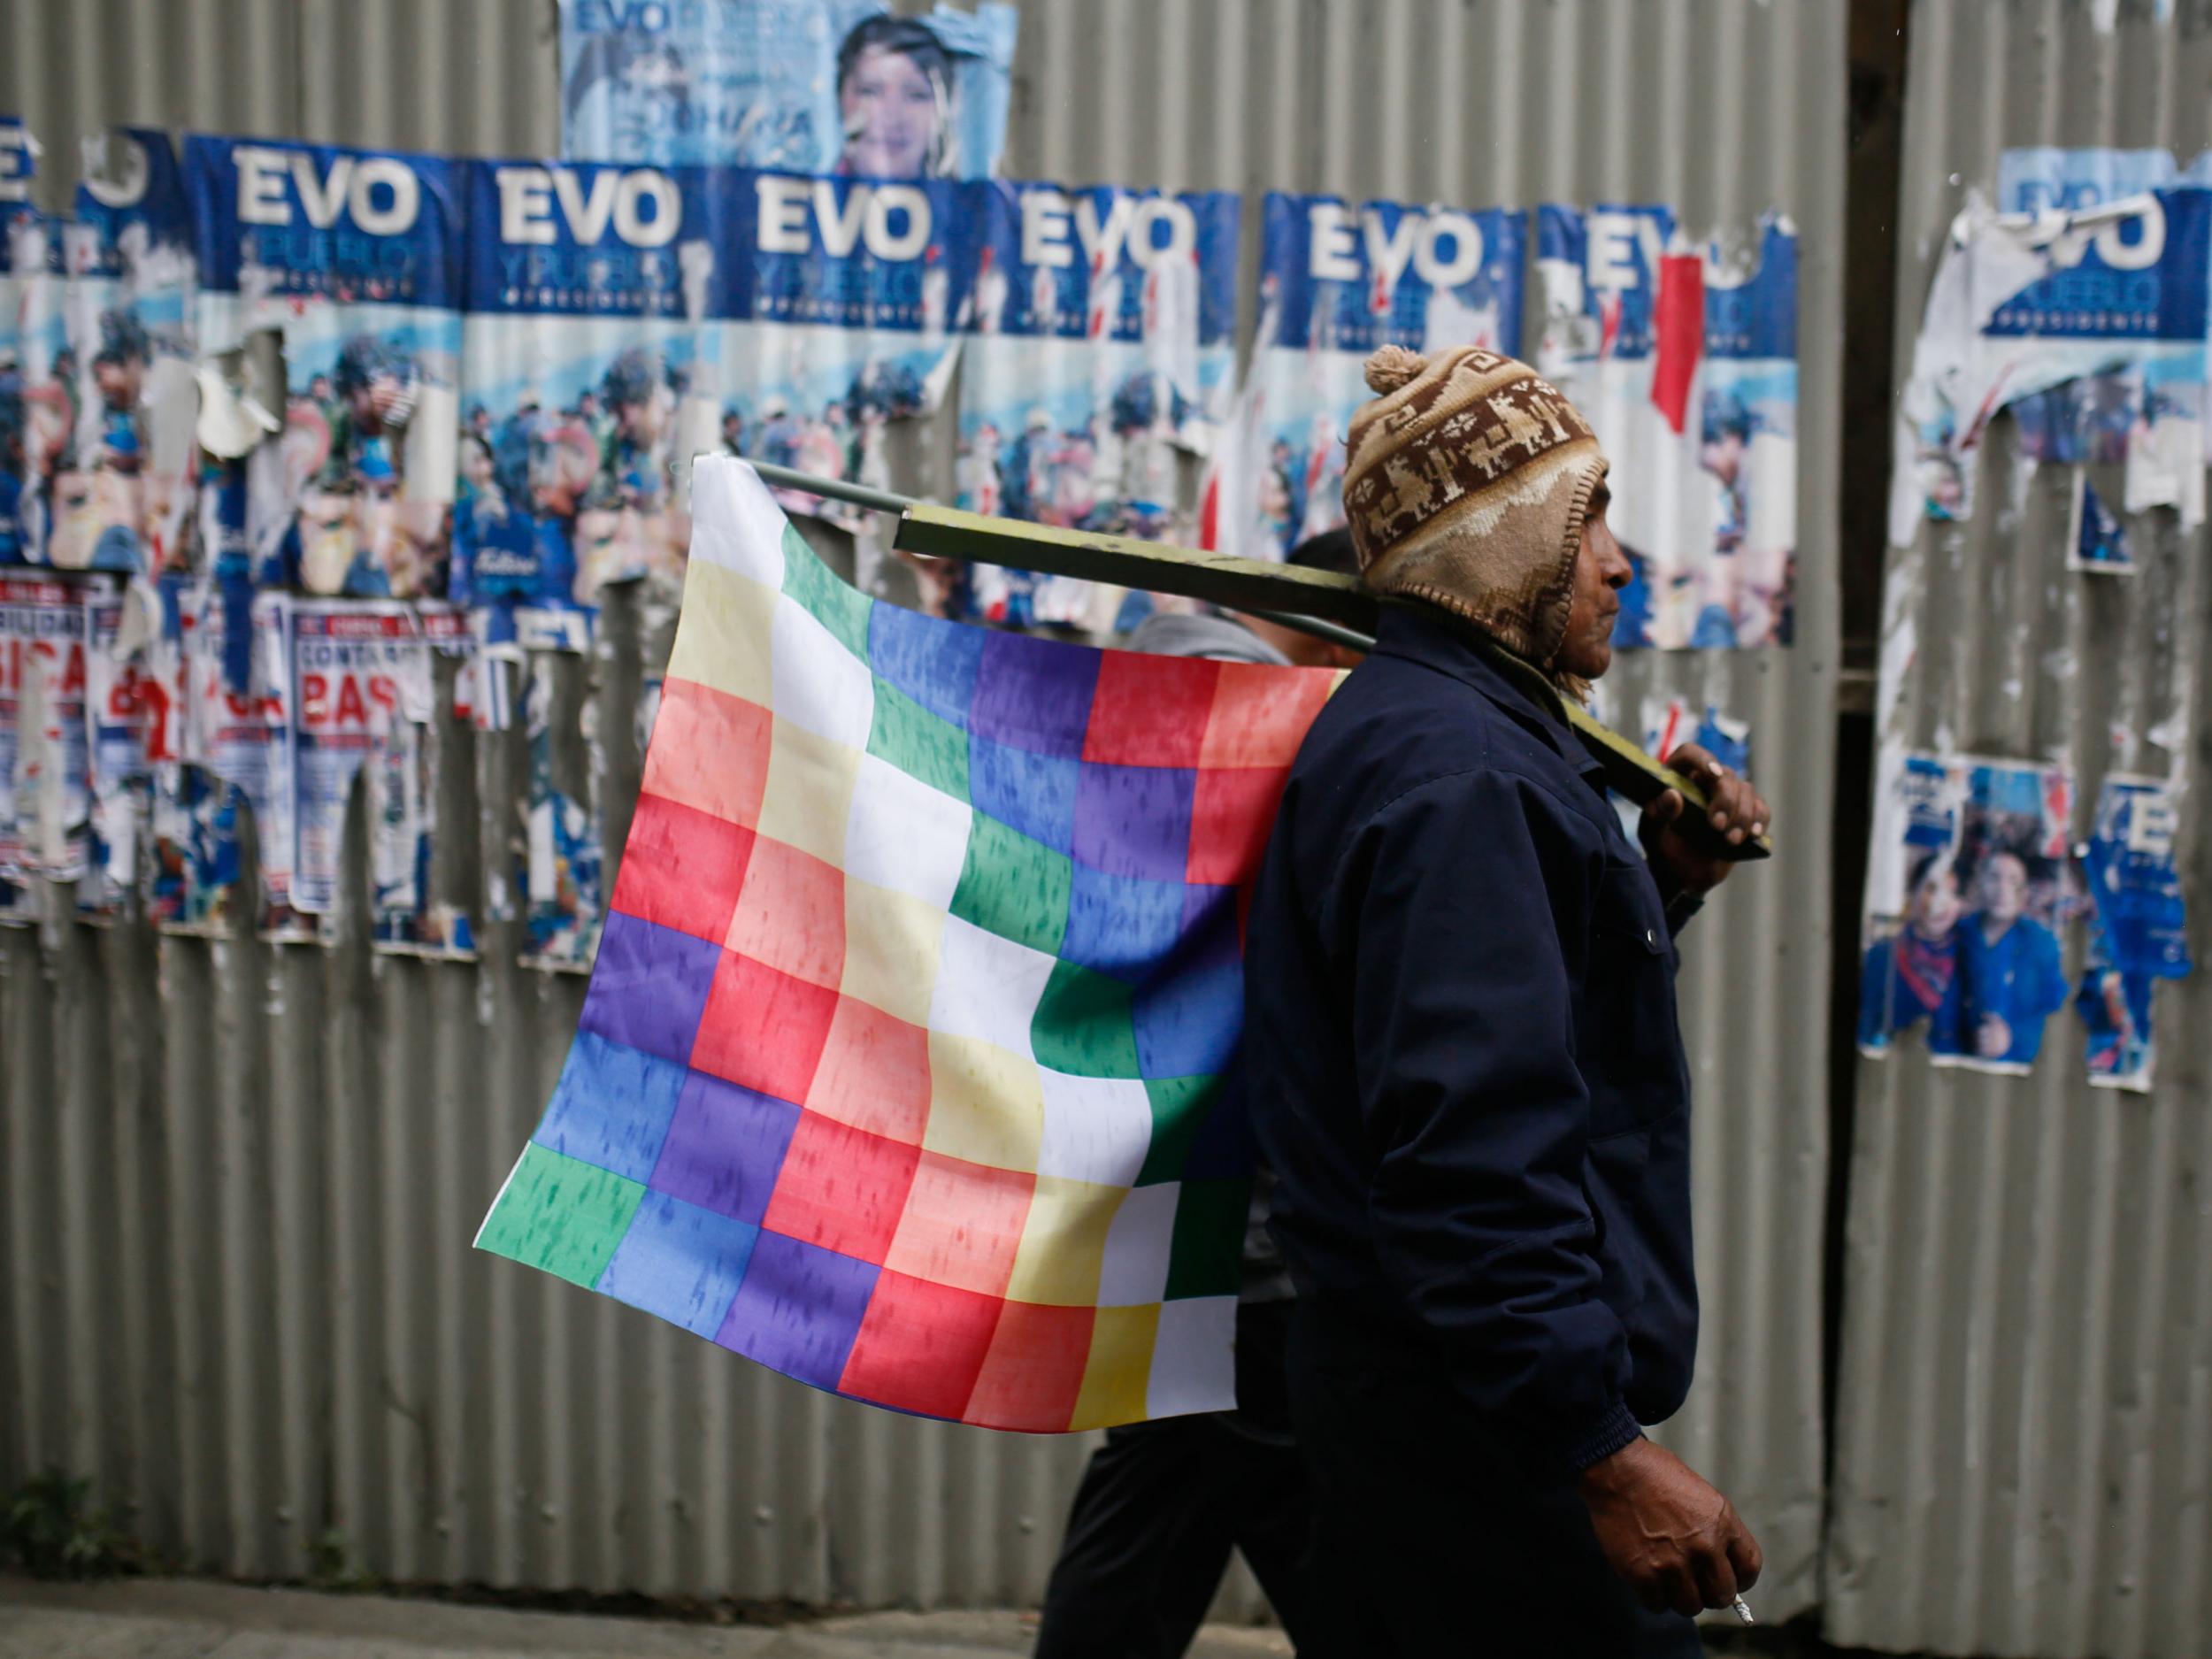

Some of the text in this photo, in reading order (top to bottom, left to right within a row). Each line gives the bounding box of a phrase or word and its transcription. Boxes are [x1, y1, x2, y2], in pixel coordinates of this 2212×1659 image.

[232, 146, 420, 236] EVO
[495, 166, 682, 248] EVO
[756, 175, 933, 262] EVO
[1020, 189, 1197, 271] EVO
[1308, 204, 1484, 288] EVO
